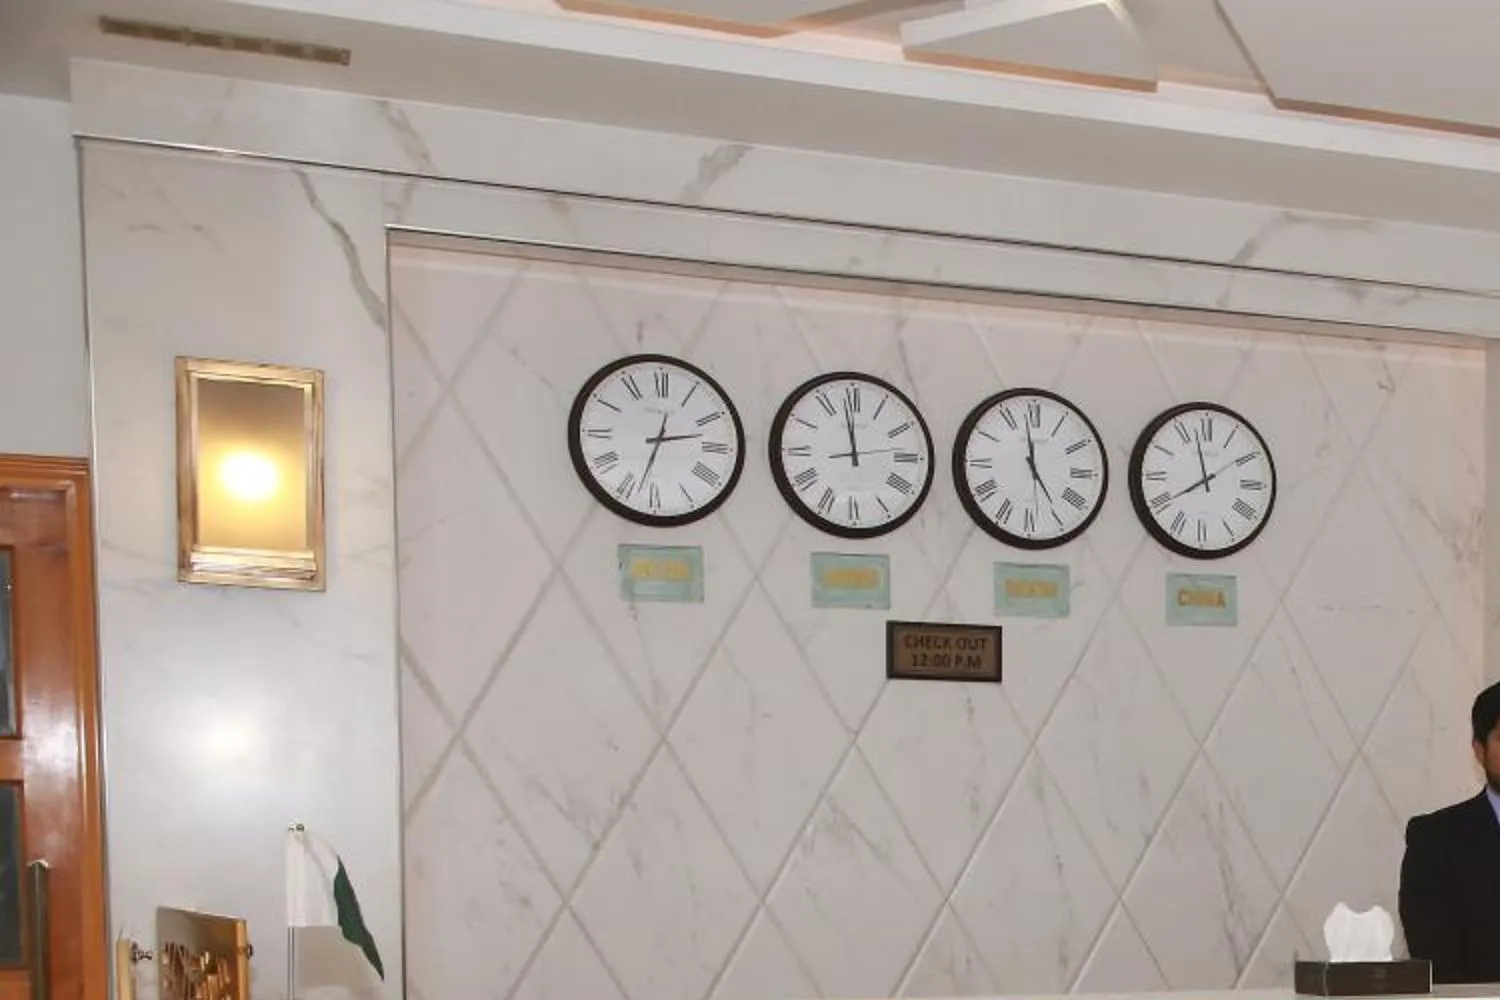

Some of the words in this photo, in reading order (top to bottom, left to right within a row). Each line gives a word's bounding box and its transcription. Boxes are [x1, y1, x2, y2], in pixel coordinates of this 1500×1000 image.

[903, 634, 952, 651] CHECK
[956, 636, 988, 652] OUT
[911, 653, 951, 668] 12:00
